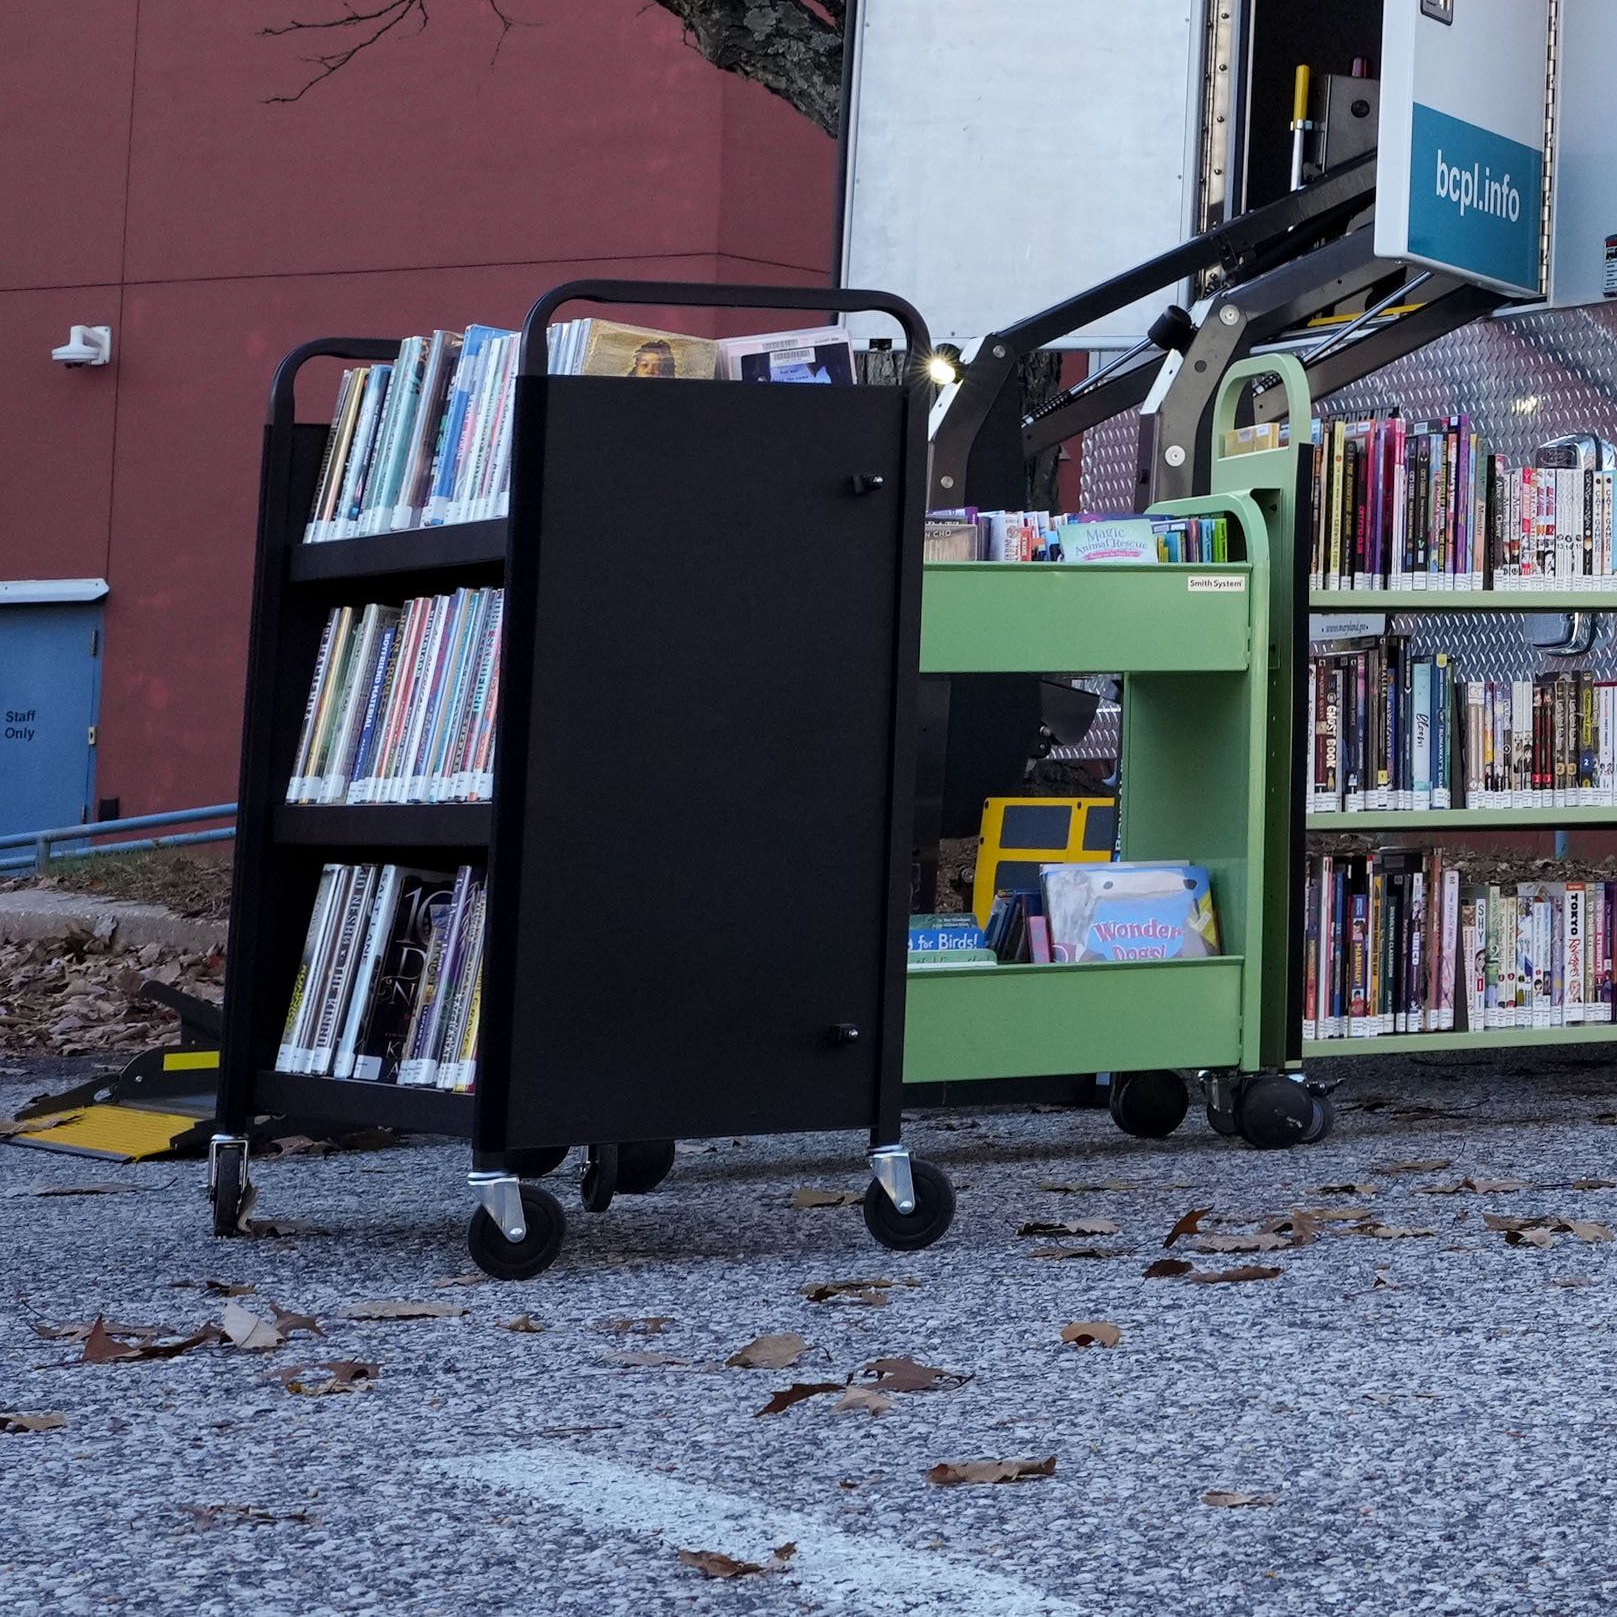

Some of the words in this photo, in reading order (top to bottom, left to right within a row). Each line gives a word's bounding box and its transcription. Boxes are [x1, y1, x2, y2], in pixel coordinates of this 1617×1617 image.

[1436, 150, 1521, 222] bcpl.info
[1075, 539, 1109, 556] Animal
[1113, 539, 1148, 550] Rescue
[1087, 528, 1125, 542] Magic
[1189, 579, 1212, 588] Smith
[1213, 579, 1240, 589] System
[374, 633, 391, 689] BOYFRIEND
[5, 710, 36, 724] Staff
[364, 689, 380, 731] MATERIAL
[1326, 705, 1336, 736] GHOST
[5, 727, 35, 742] Only
[1416, 713, 1429, 748] Bloom
[1326, 739, 1336, 768] BOOK
[373, 872, 388, 916] SALT
[362, 922, 376, 966] LANE
[918, 936, 933, 950] for
[938, 934, 977, 950] Birds!
[1094, 919, 1182, 942] Wonder
[332, 965, 345, 993] THE
[1354, 943, 1363, 987] MABUHAY!
[461, 997, 478, 1057] GRAVES
